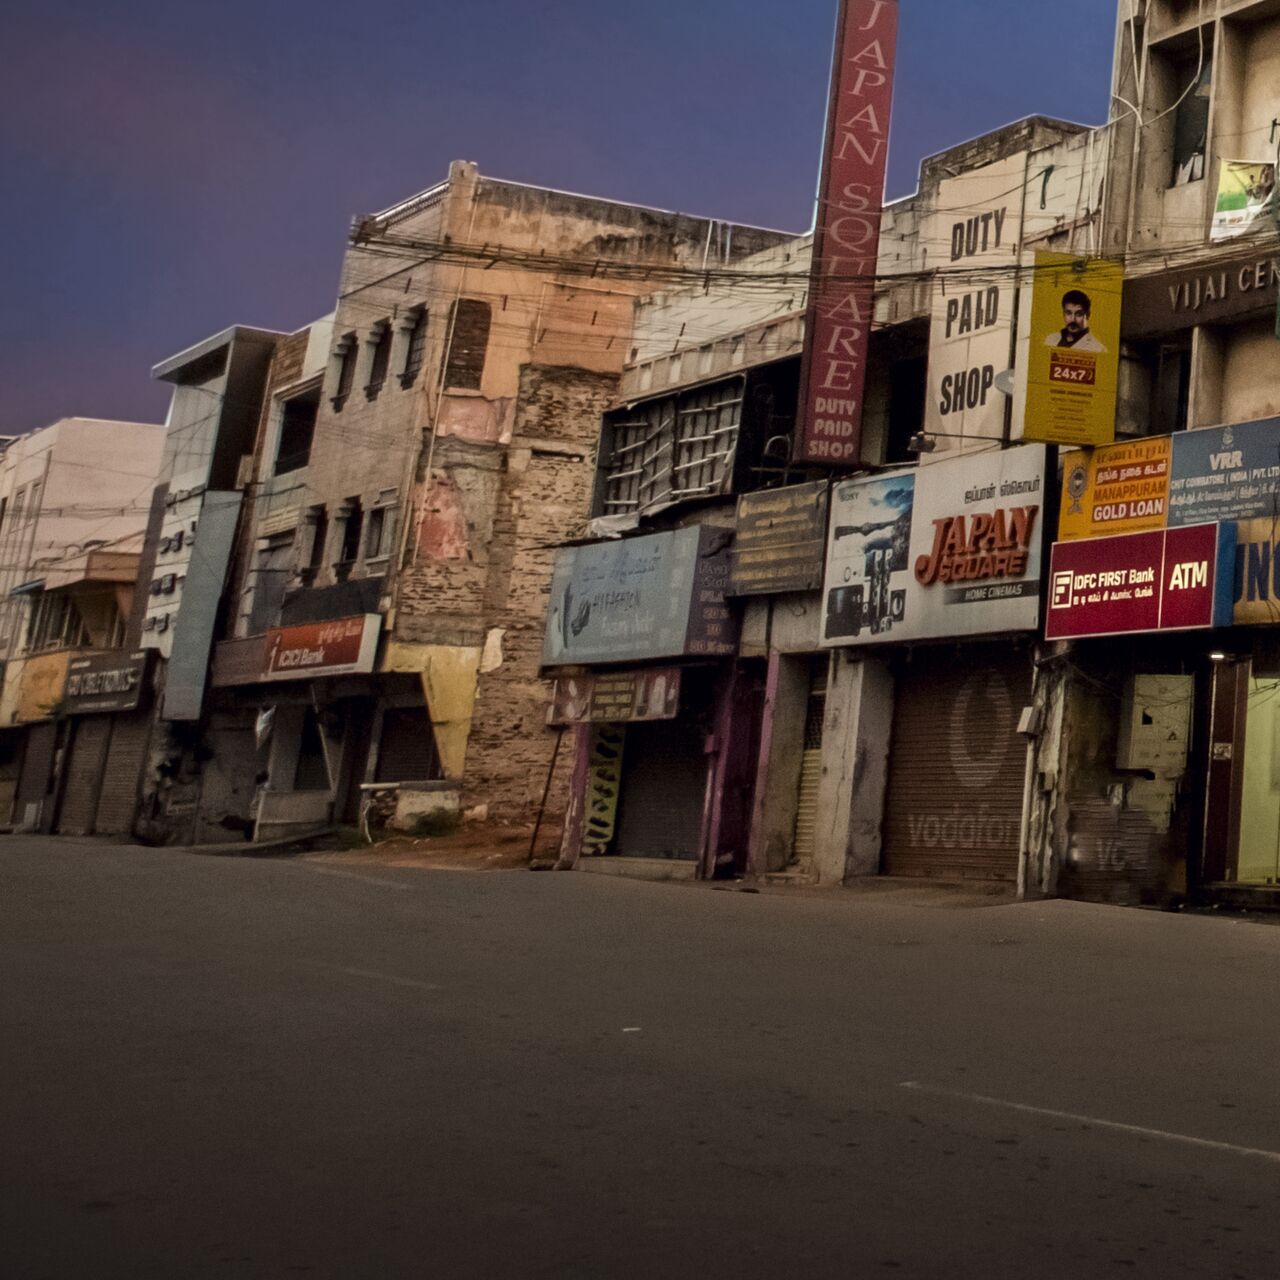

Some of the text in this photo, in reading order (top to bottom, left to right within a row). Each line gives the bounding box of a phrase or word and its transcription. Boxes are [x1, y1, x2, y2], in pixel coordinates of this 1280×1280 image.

[833, 0, 888, 165] JAPAN
[951, 207, 1007, 261] DUTY
[819, 182, 876, 394] SQUARE
[945, 285, 999, 338] PAID
[940, 362, 994, 416] SHOP
[814, 398, 857, 418] DUTY
[813, 418, 854, 438] PAID
[807, 439, 855, 460] SHOP
[1094, 480, 1167, 502] MANAPPURAM
[1094, 504, 1126, 520] GOLD
[1130, 499, 1164, 516] LOAN
[915, 505, 1039, 586] JAPAN
[938, 550, 1028, 582] SQUARE
[1074, 567, 1154, 590] IDFC FIRST Bank
[1169, 561, 1208, 590] ATM
[965, 584, 1022, 600] HOME CINEMAS
